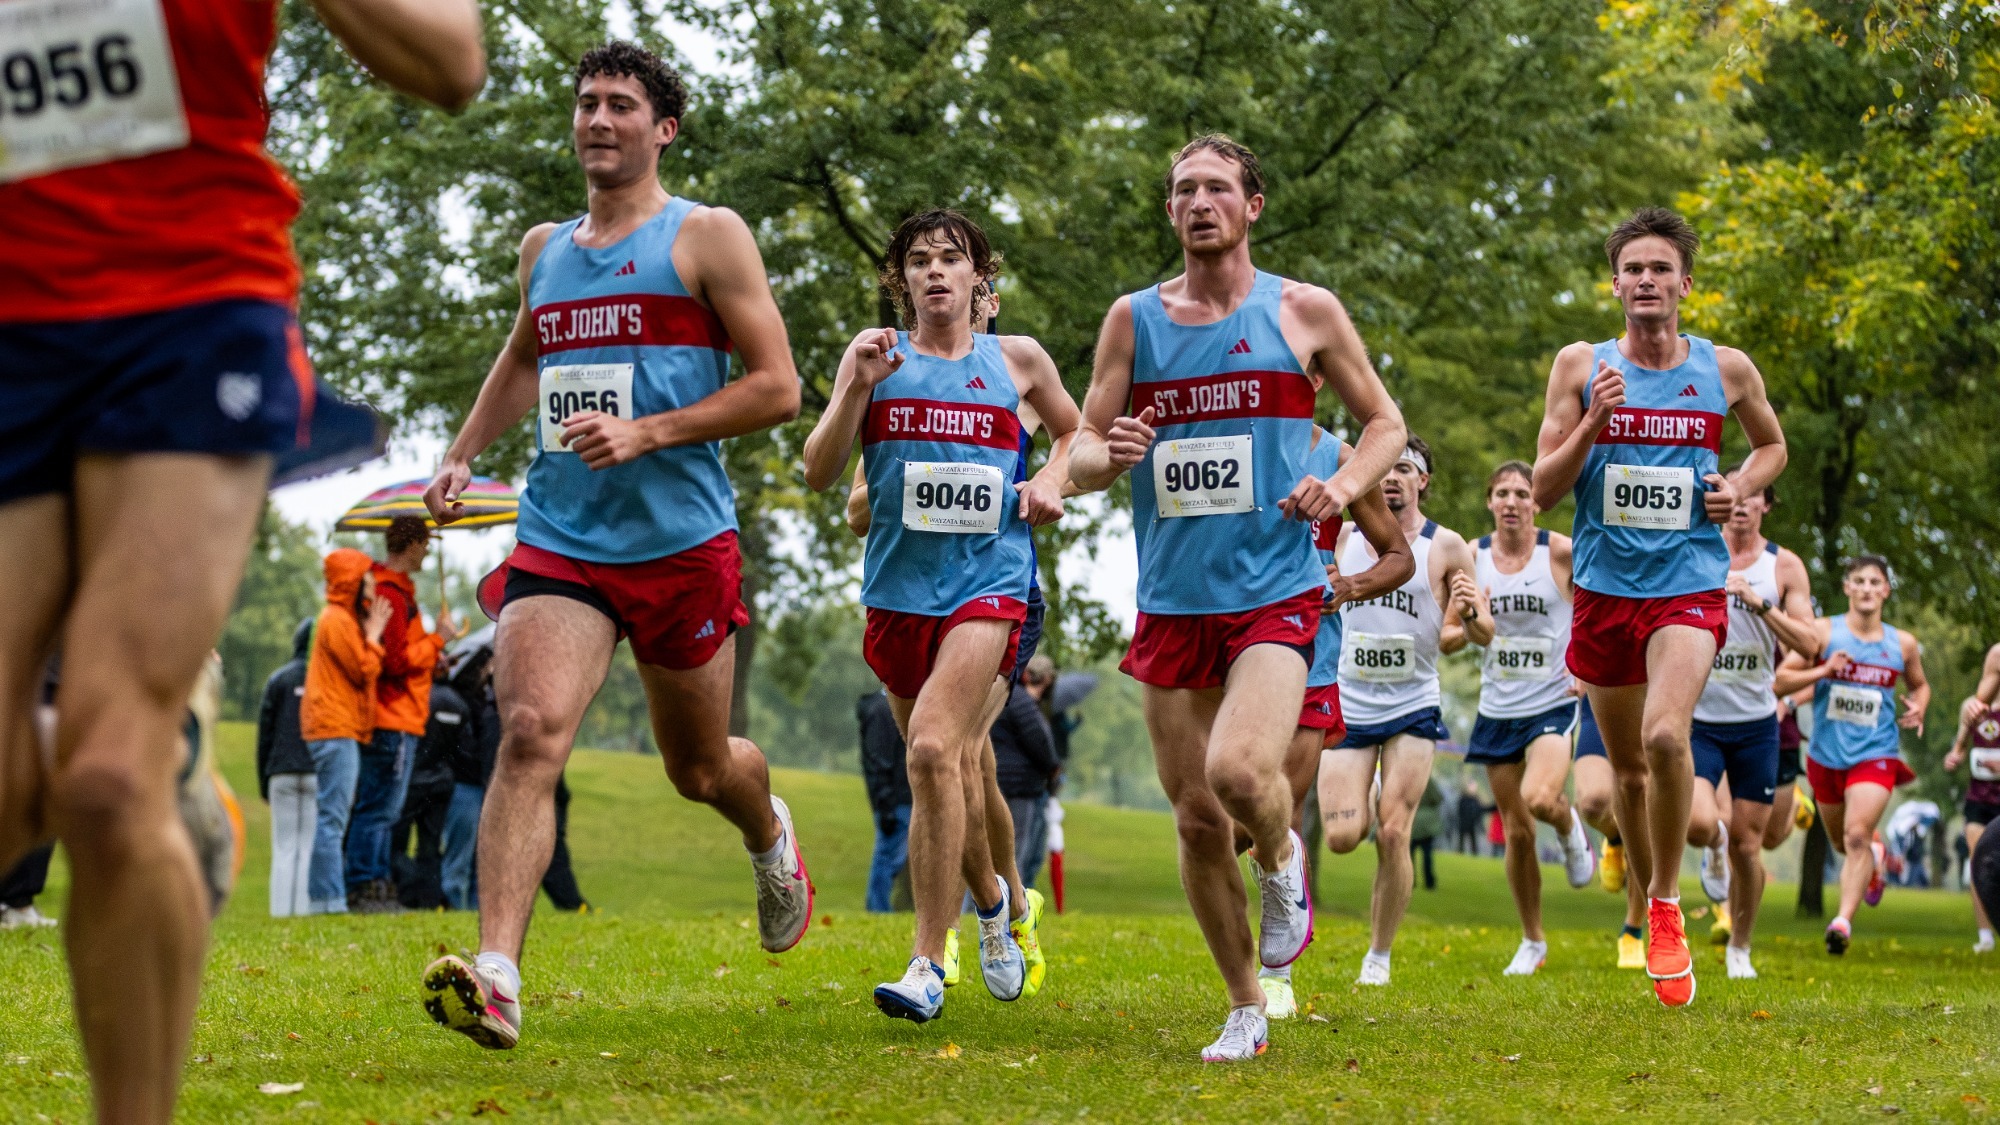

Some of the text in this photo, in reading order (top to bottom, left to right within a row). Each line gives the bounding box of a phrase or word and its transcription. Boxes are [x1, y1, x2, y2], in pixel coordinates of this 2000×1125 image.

[0, 33, 142, 118] 956
[538, 303, 642, 345] ST. JOHN'S
[549, 390, 619, 425] 9056
[1154, 379, 1261, 418] ST. JOHN'S
[889, 407, 994, 438] ST. JOHN'S
[1609, 414, 1706, 440] ST. JOHN'S
[1165, 458, 1240, 493] 9062
[916, 482, 992, 512] 9046
[1614, 483, 1682, 510] 9053
[1489, 594, 1548, 616] ETHEL
[1354, 648, 1406, 668] 8863
[1498, 650, 1544, 668] 8879
